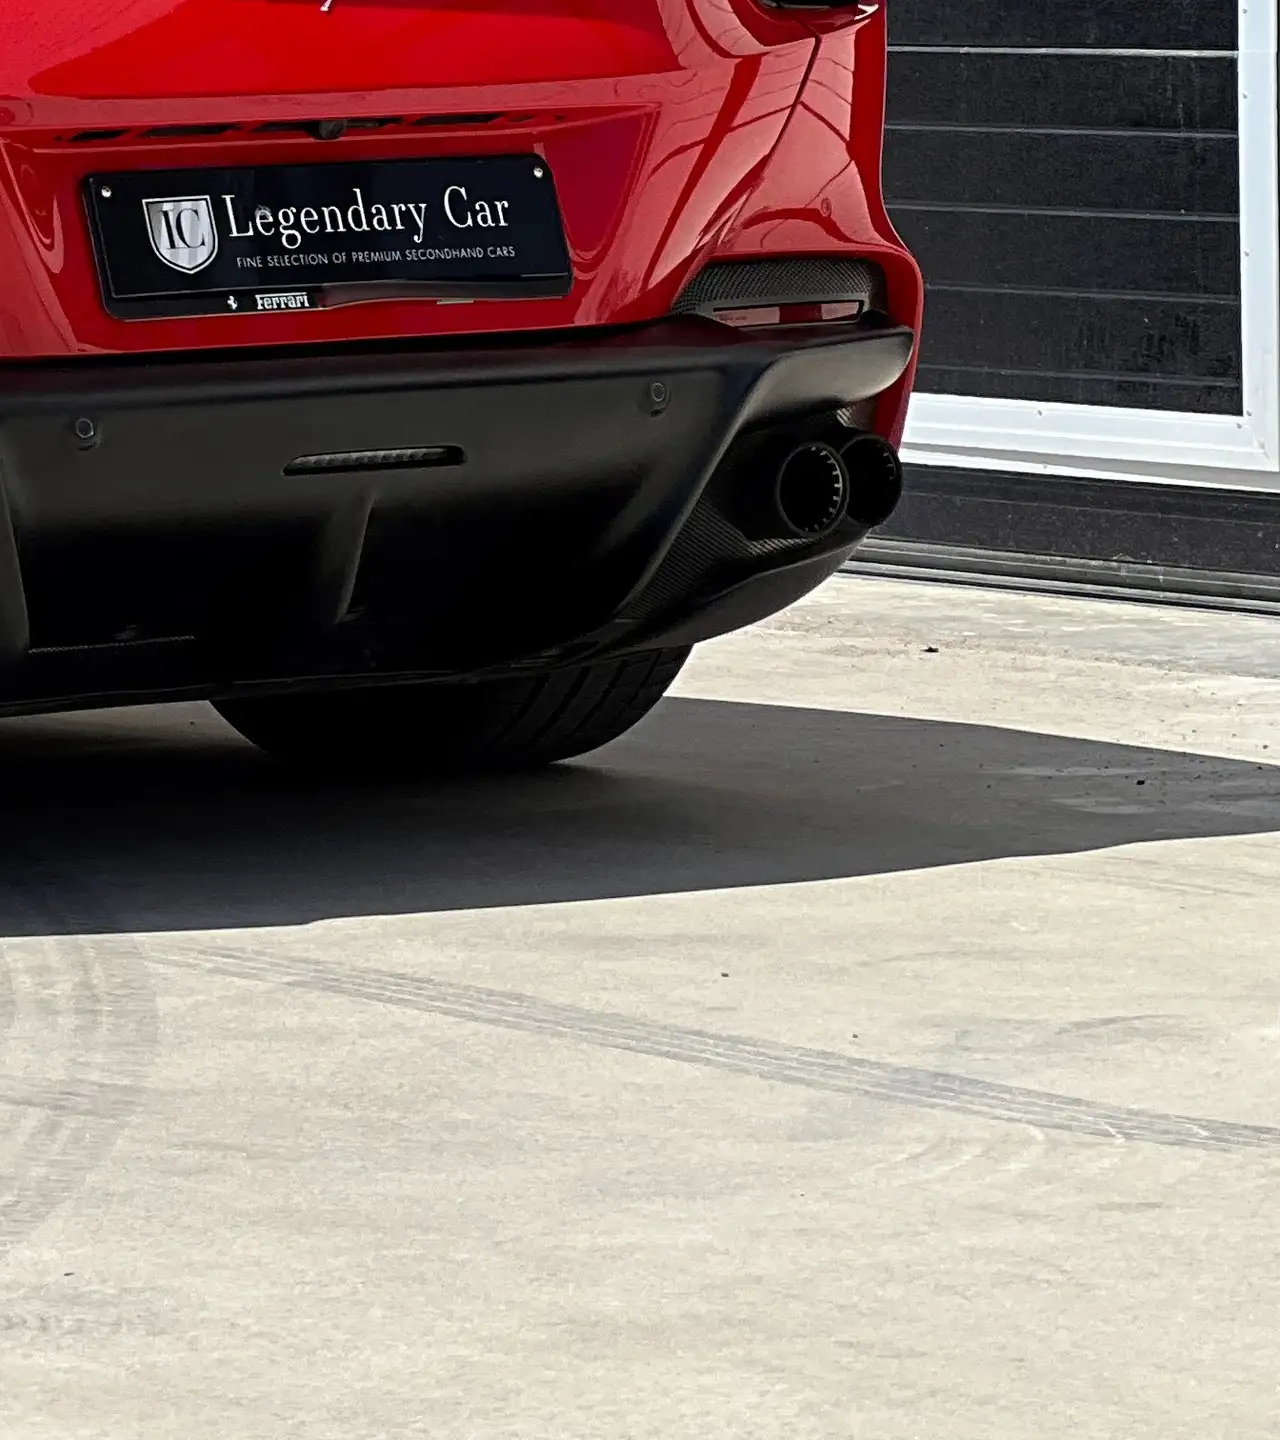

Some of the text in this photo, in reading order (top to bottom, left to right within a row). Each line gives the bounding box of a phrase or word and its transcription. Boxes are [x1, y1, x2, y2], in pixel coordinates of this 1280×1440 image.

[221, 185, 509, 249] Legendary Car
[236, 245, 516, 268] FINE SELECTION OF PREMIUM SECONDHAND CARS
[254, 291, 310, 310] Ferrari
